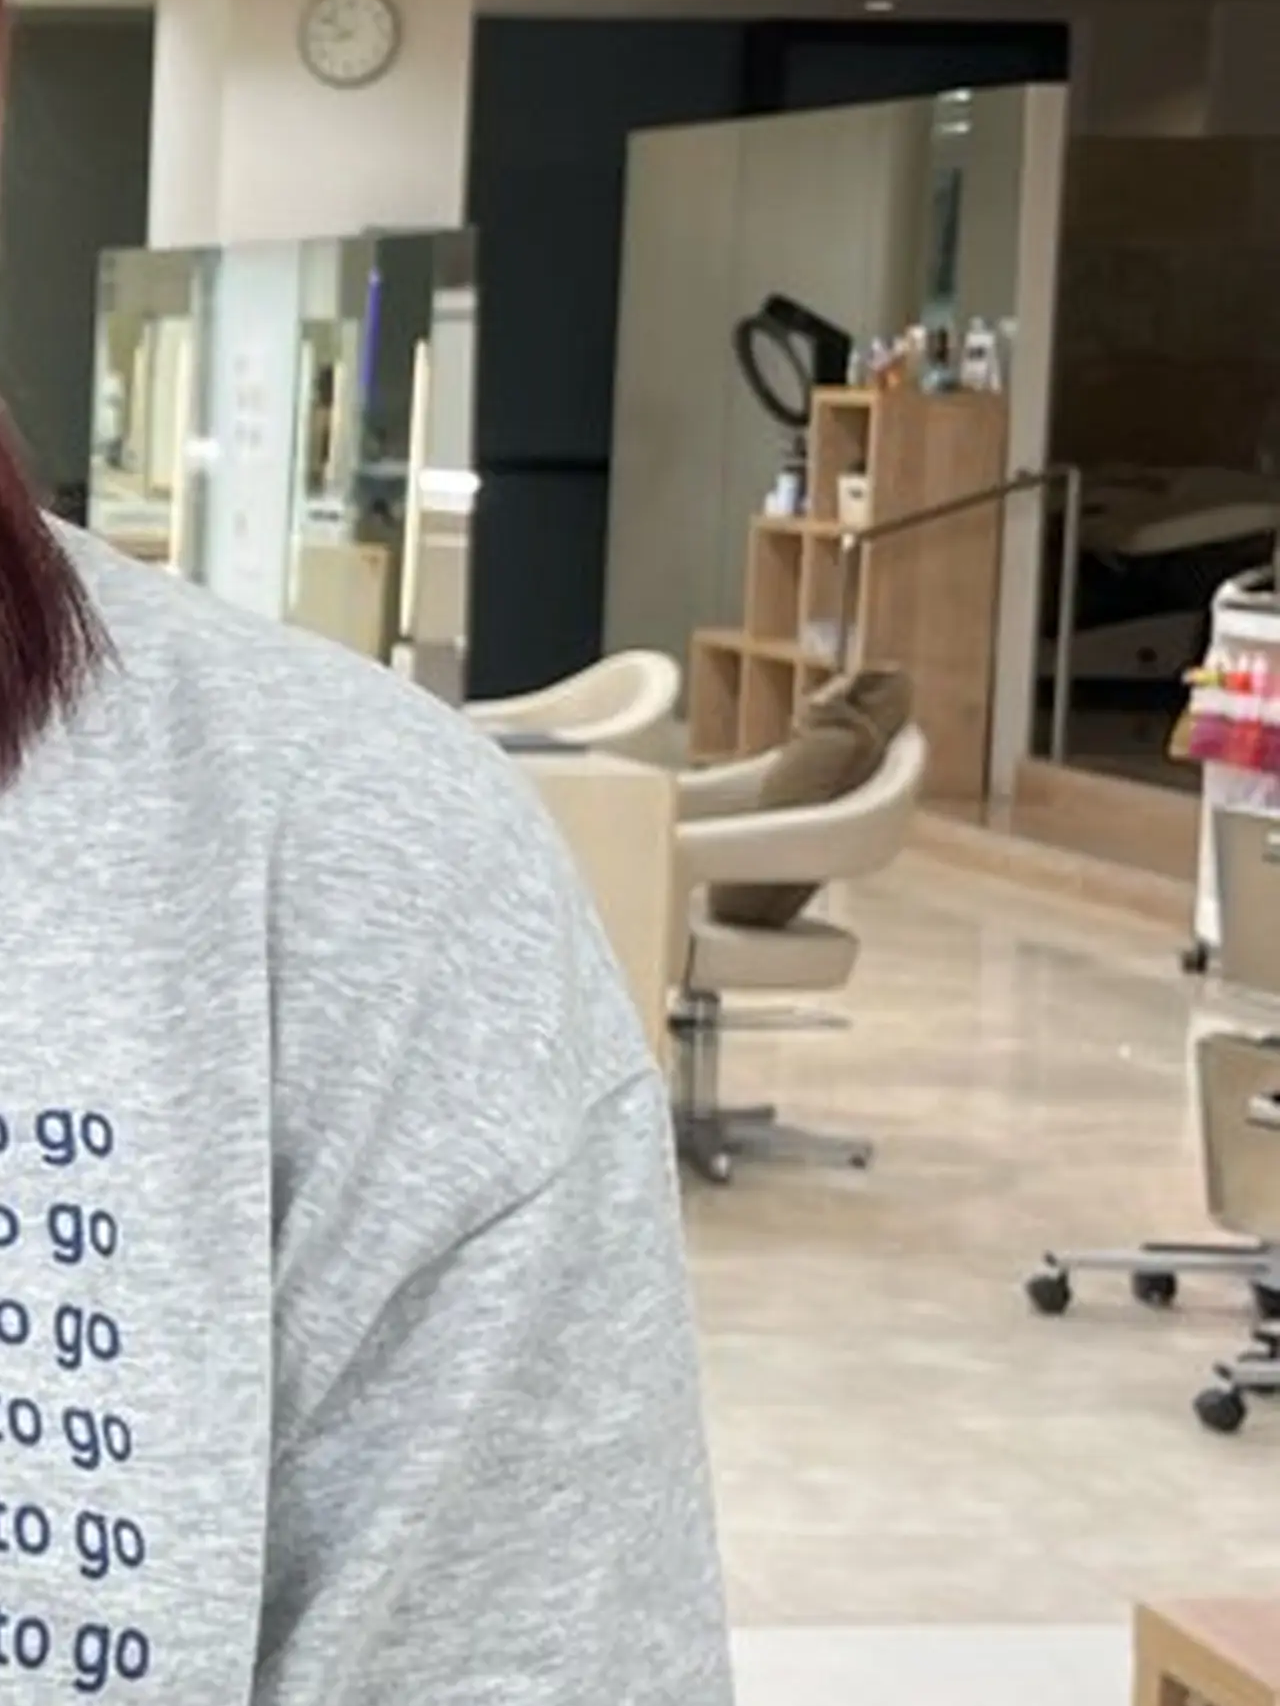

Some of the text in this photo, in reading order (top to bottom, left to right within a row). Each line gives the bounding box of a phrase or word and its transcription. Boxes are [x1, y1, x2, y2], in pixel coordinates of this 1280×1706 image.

[35, 1109, 114, 1167] go
[47, 1202, 118, 1265] go
[54, 1303, 121, 1371] go
[62, 1407, 132, 1471] go
[75, 1510, 146, 1581] go
[71, 1622, 150, 1694] go
